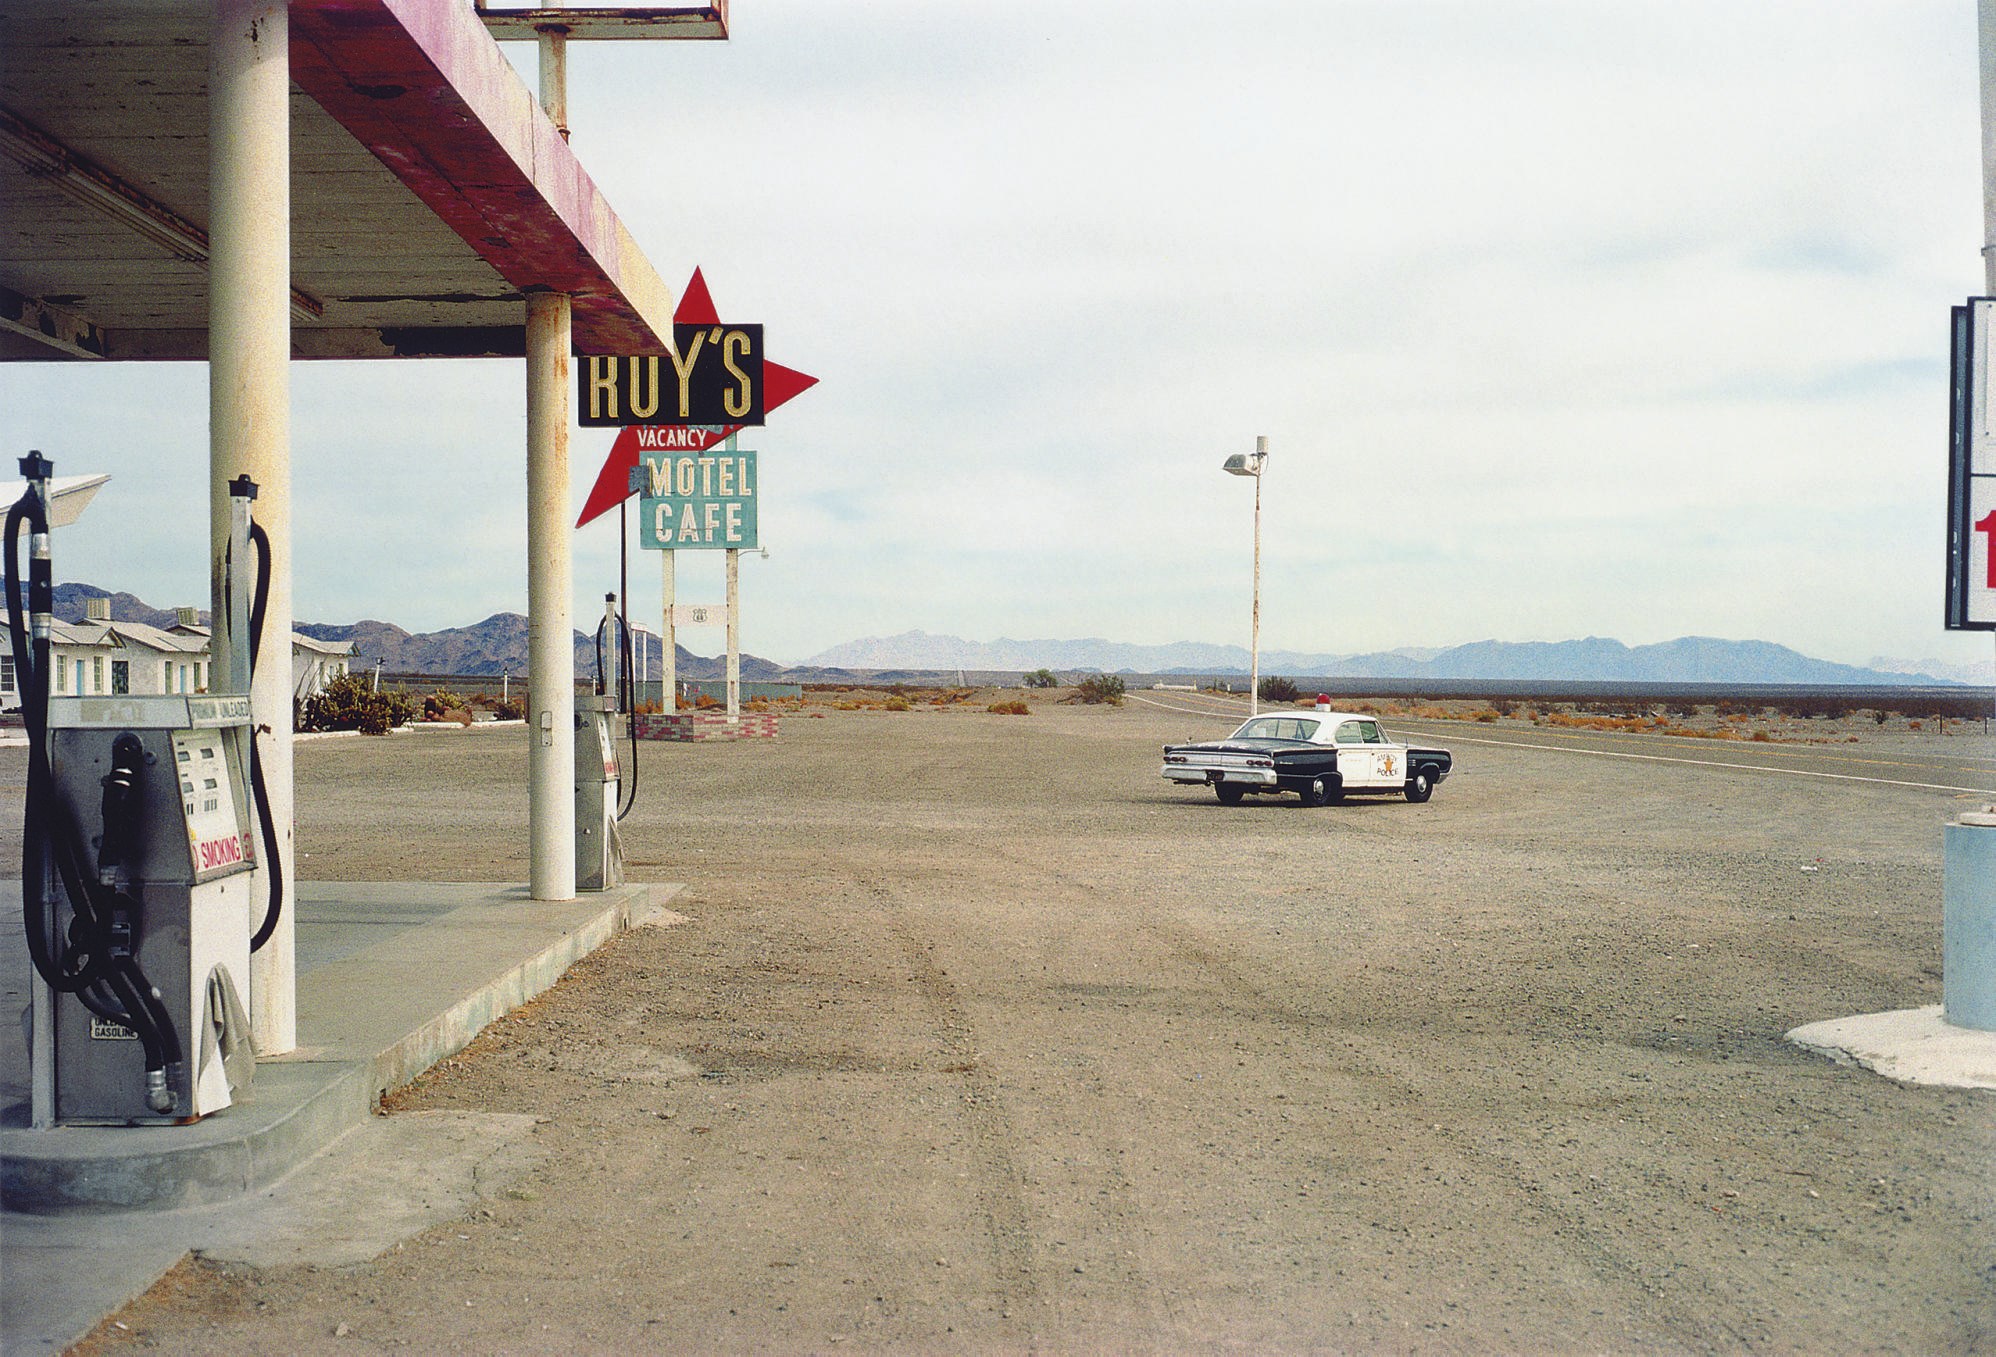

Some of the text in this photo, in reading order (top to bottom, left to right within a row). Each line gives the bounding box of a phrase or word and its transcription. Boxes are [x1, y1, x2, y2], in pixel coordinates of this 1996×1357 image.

[589, 325, 752, 419] ROY'S
[637, 428, 708, 447] VACANCY
[647, 457, 752, 496] MOTEL
[655, 502, 742, 543] CAFE
[1376, 768, 1398, 776] POLICE
[201, 835, 241, 869] SMOKING
